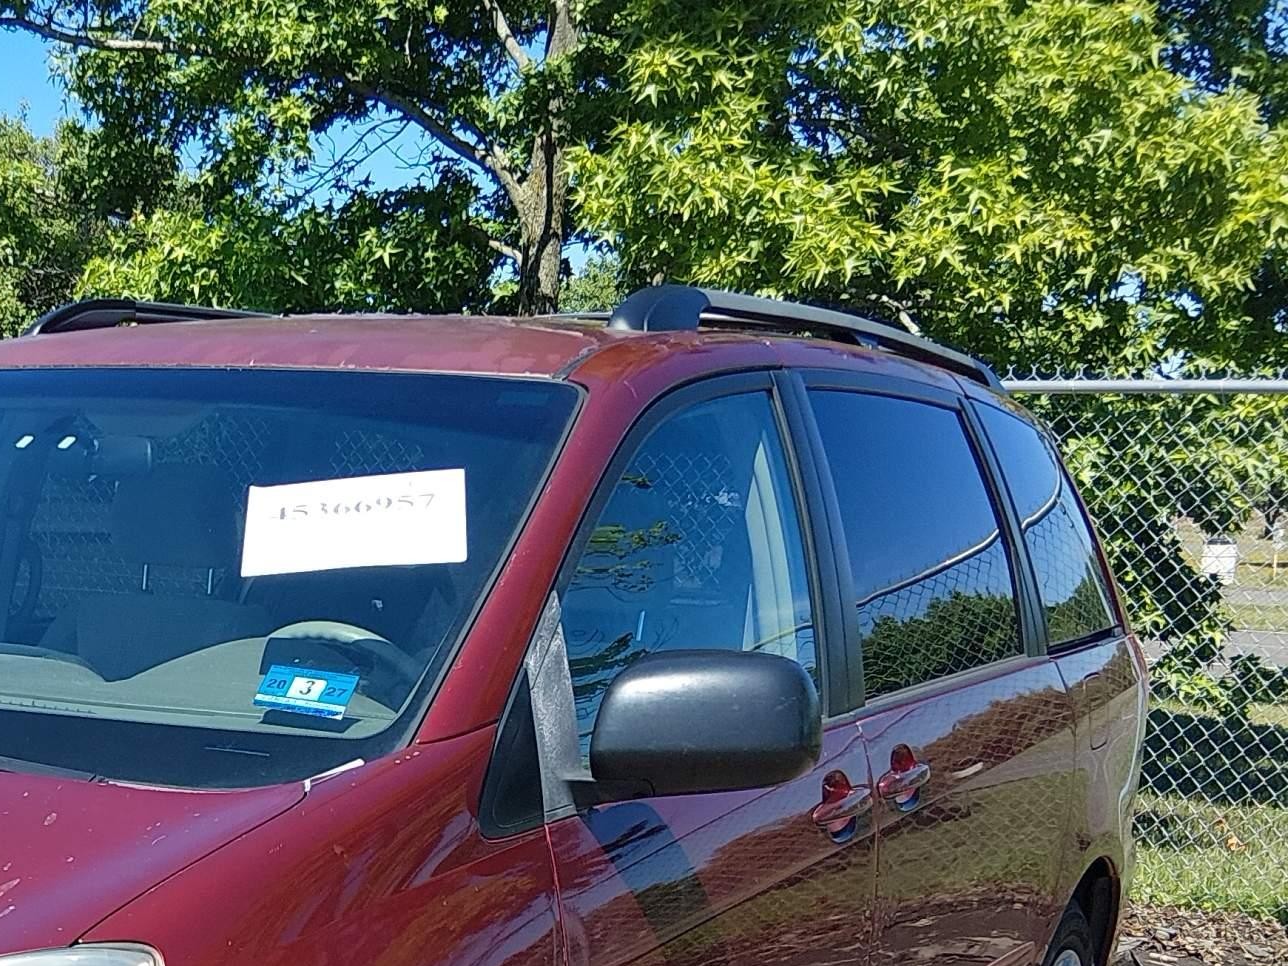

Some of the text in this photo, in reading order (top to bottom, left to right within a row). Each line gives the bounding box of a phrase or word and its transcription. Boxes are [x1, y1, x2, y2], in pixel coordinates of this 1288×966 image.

[270, 493, 436, 522] 45366957
[267, 679, 347, 698] 20 3 27
